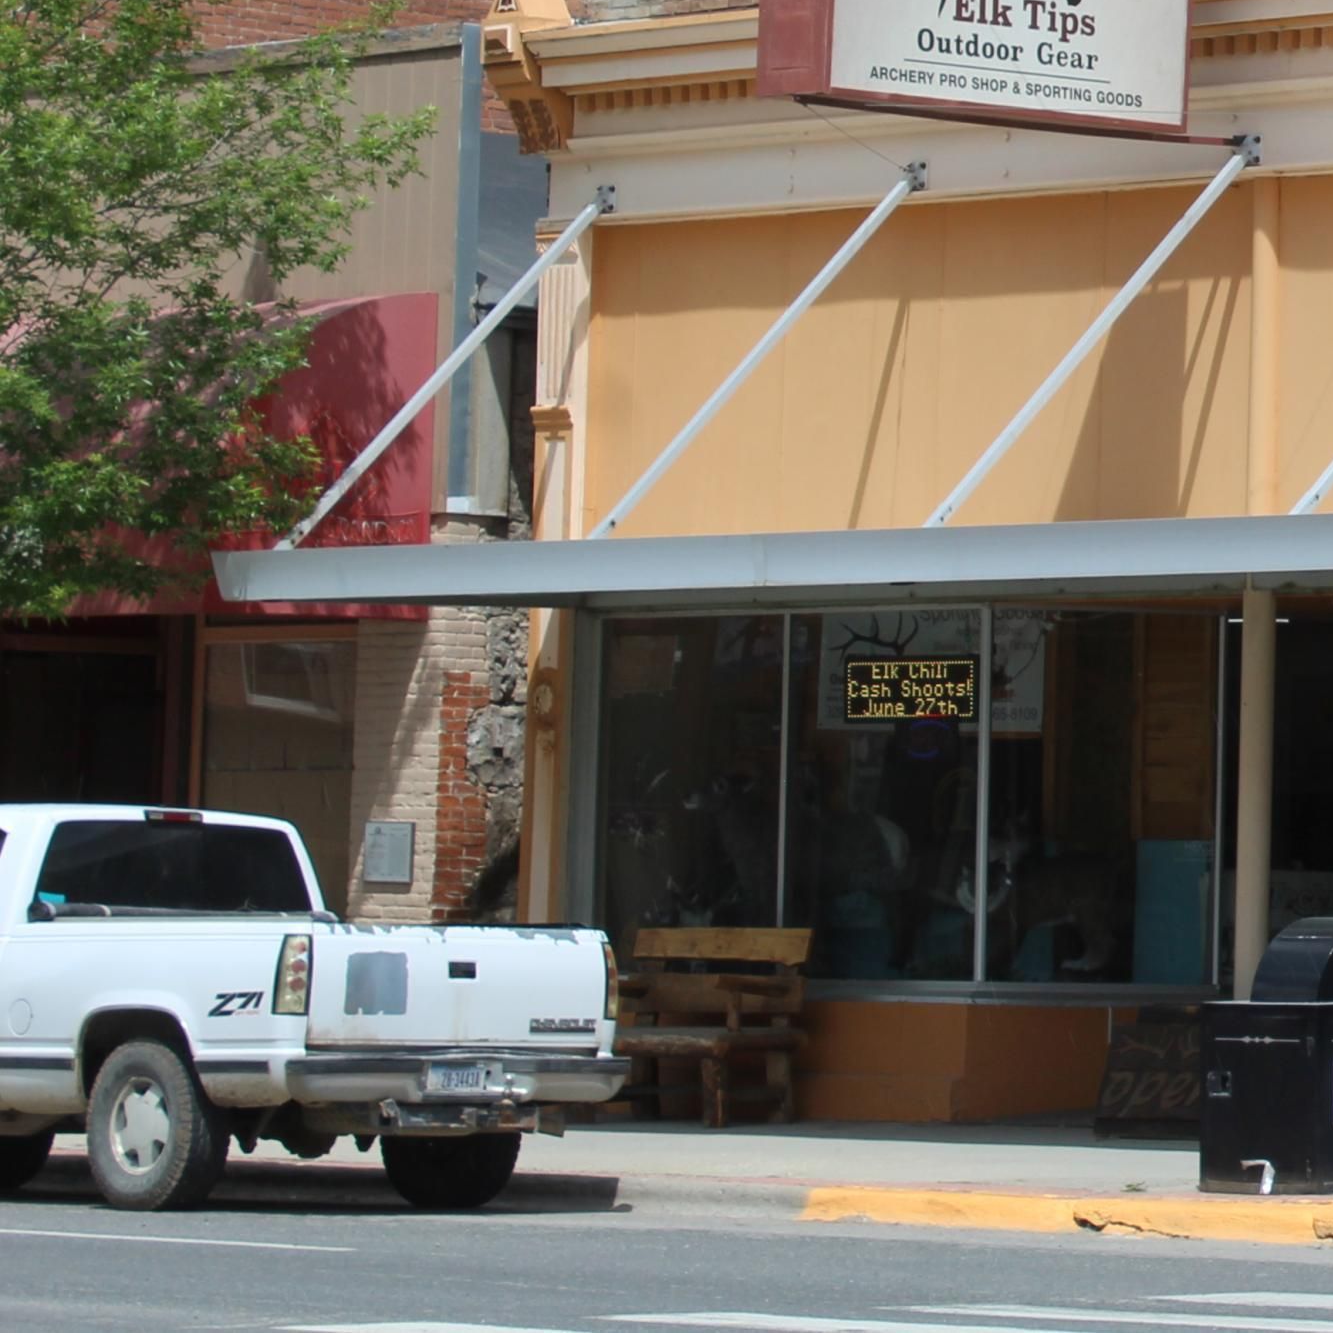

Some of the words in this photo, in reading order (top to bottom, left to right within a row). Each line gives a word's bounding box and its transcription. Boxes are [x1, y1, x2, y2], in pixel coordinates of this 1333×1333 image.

[1023, 0, 1096, 42] Tips
[917, 29, 1023, 62] Outdoor
[1036, 42, 1099, 70] Gear
[869, 67, 935, 86] ARCHERY
[939, 73, 967, 90] PRO
[971, 76, 1008, 94] SHOP
[1012, 80, 1021, 94] &
[1025, 82, 1093, 103] SPORTING
[1096, 89, 1143, 108] GOODS
[871, 664, 900, 680] Elk
[908, 664, 948, 679] Chili
[849, 681, 891, 698] Cash
[901, 679, 973, 697] Shoots!
[863, 699, 905, 716] June
[914, 698, 959, 716] 27th
[208, 991, 265, 1017] Z71
